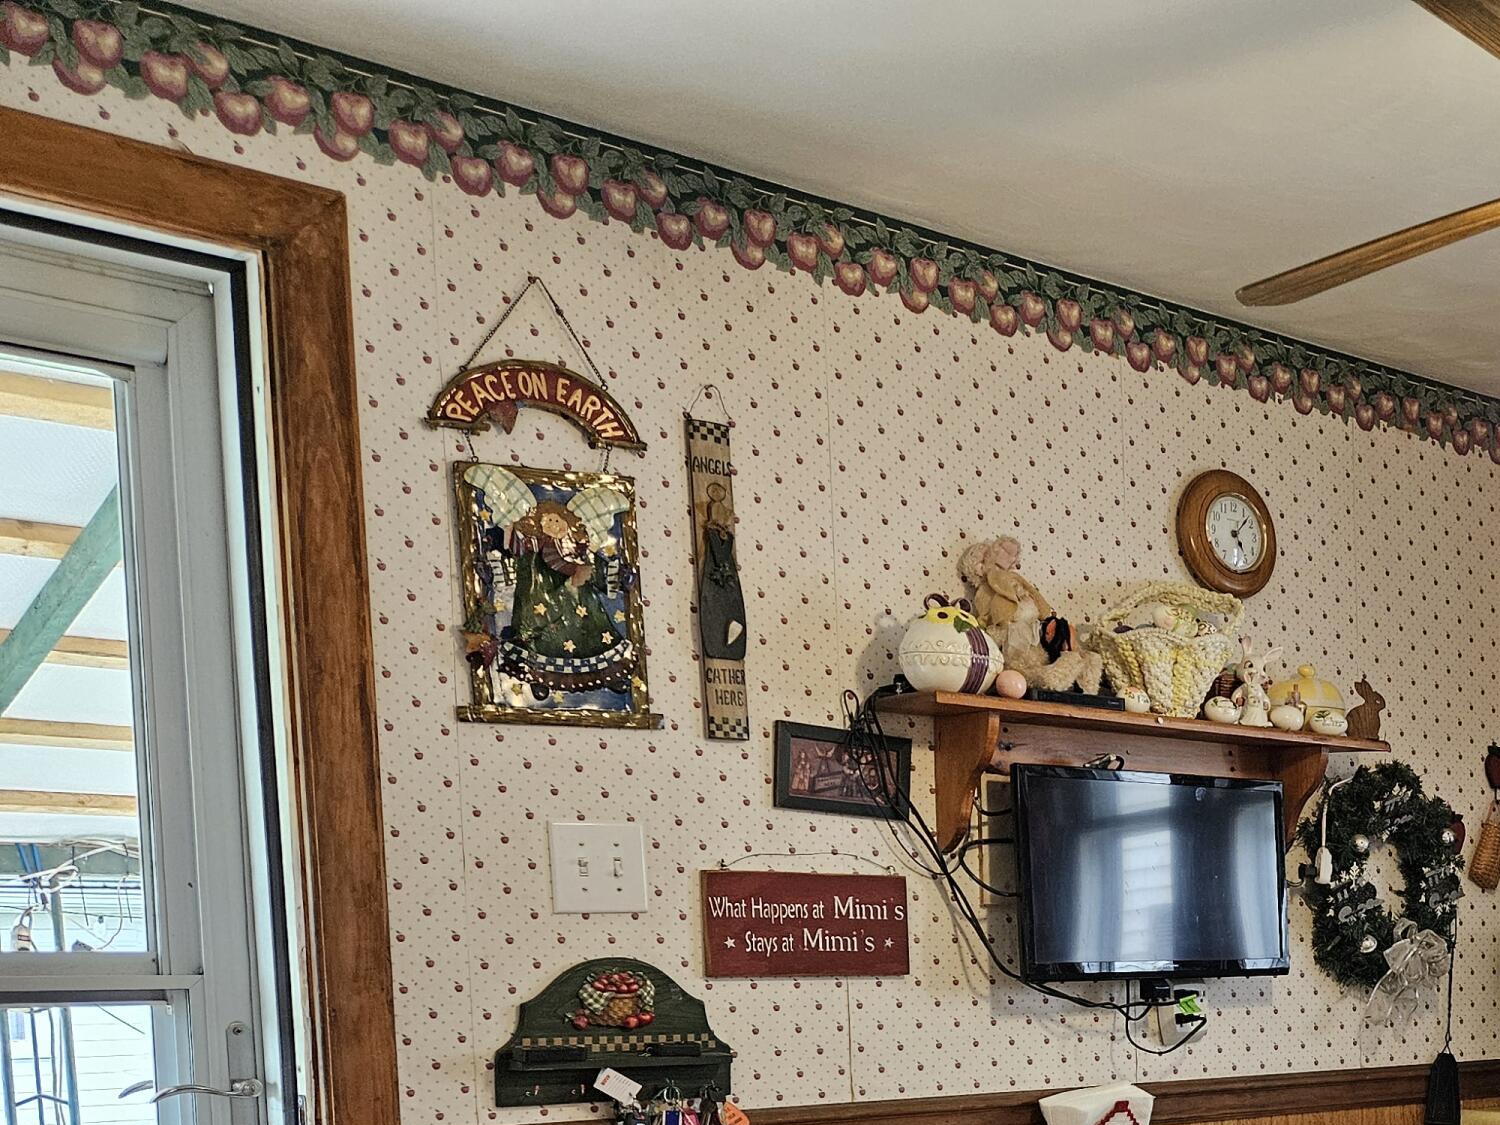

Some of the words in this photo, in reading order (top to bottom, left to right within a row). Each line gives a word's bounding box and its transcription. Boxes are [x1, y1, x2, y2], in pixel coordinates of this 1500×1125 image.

[446, 371, 516, 422] PEACE
[518, 371, 548, 400] ON
[556, 377, 624, 438] EARTH
[692, 456, 734, 477] ANGELS
[1220, 502, 1227, 513] 11
[1230, 501, 1238, 512] 12
[1212, 511, 1220, 521] 10
[1211, 524, 1216, 534] 9
[1249, 519, 1254, 529] 2
[1214, 538, 1219, 548] 8
[1252, 533, 1257, 543] 3
[1222, 549, 1226, 559] 7
[706, 667, 746, 685] GATHER
[715, 689, 744, 706] HERE
[709, 896, 747, 918] What
[752, 897, 808, 924] Happens
[812, 901, 824, 919] at
[745, 931, 778, 957] Stays
[782, 934, 794, 952] at
[803, 928, 875, 952] Mimi's
